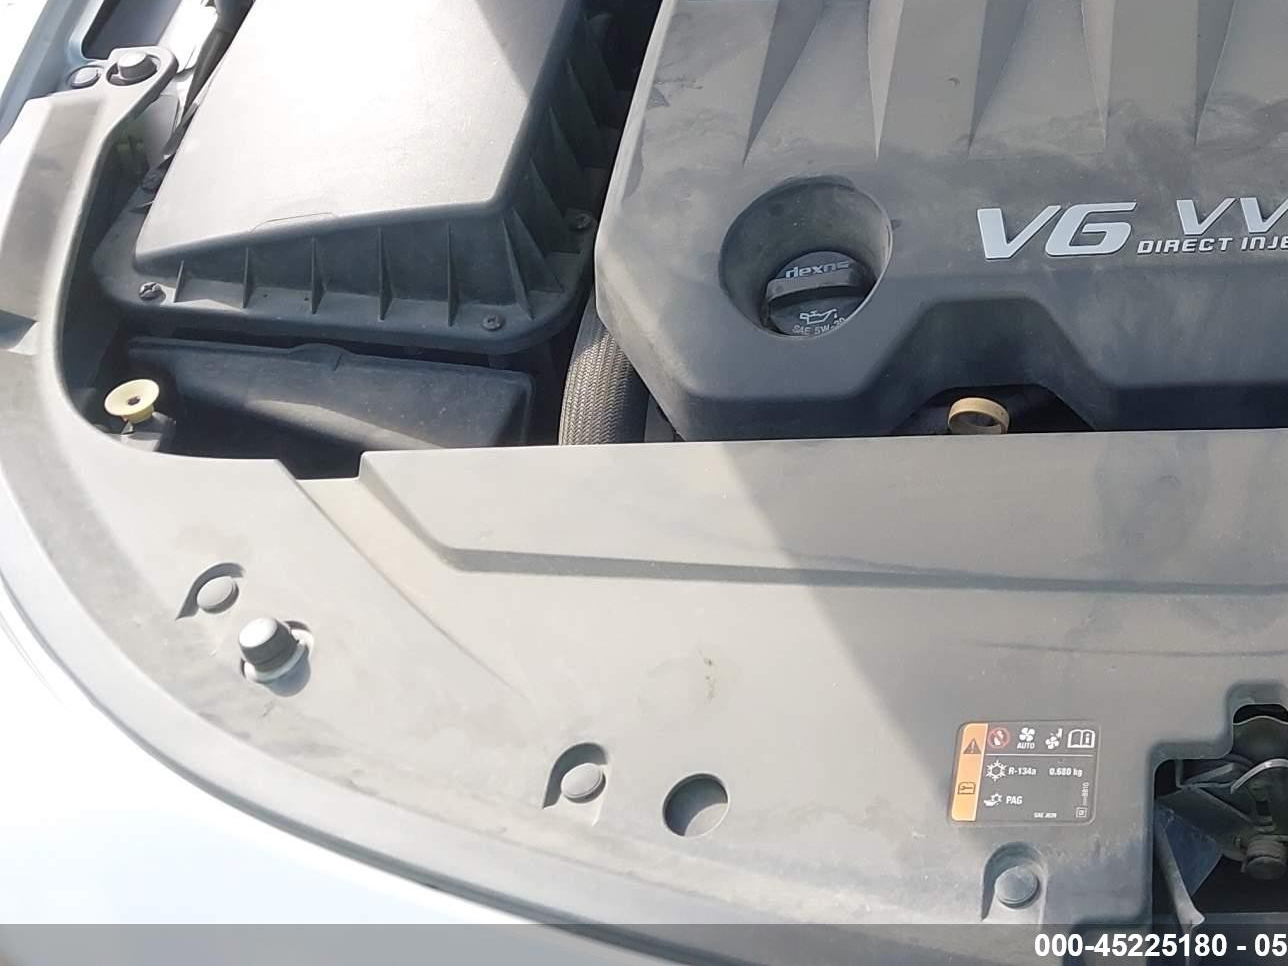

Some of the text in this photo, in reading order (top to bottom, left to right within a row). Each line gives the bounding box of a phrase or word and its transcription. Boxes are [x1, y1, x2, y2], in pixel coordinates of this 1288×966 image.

[977, 202, 1137, 260] V6
[1136, 235, 1233, 255] DIRECT
[792, 324, 811, 335] SAE
[1017, 742, 1035, 750] AUTO
[1008, 767, 1037, 776] R-134a
[1073, 767, 1083, 778] kg
[1006, 795, 1023, 805] PAG
